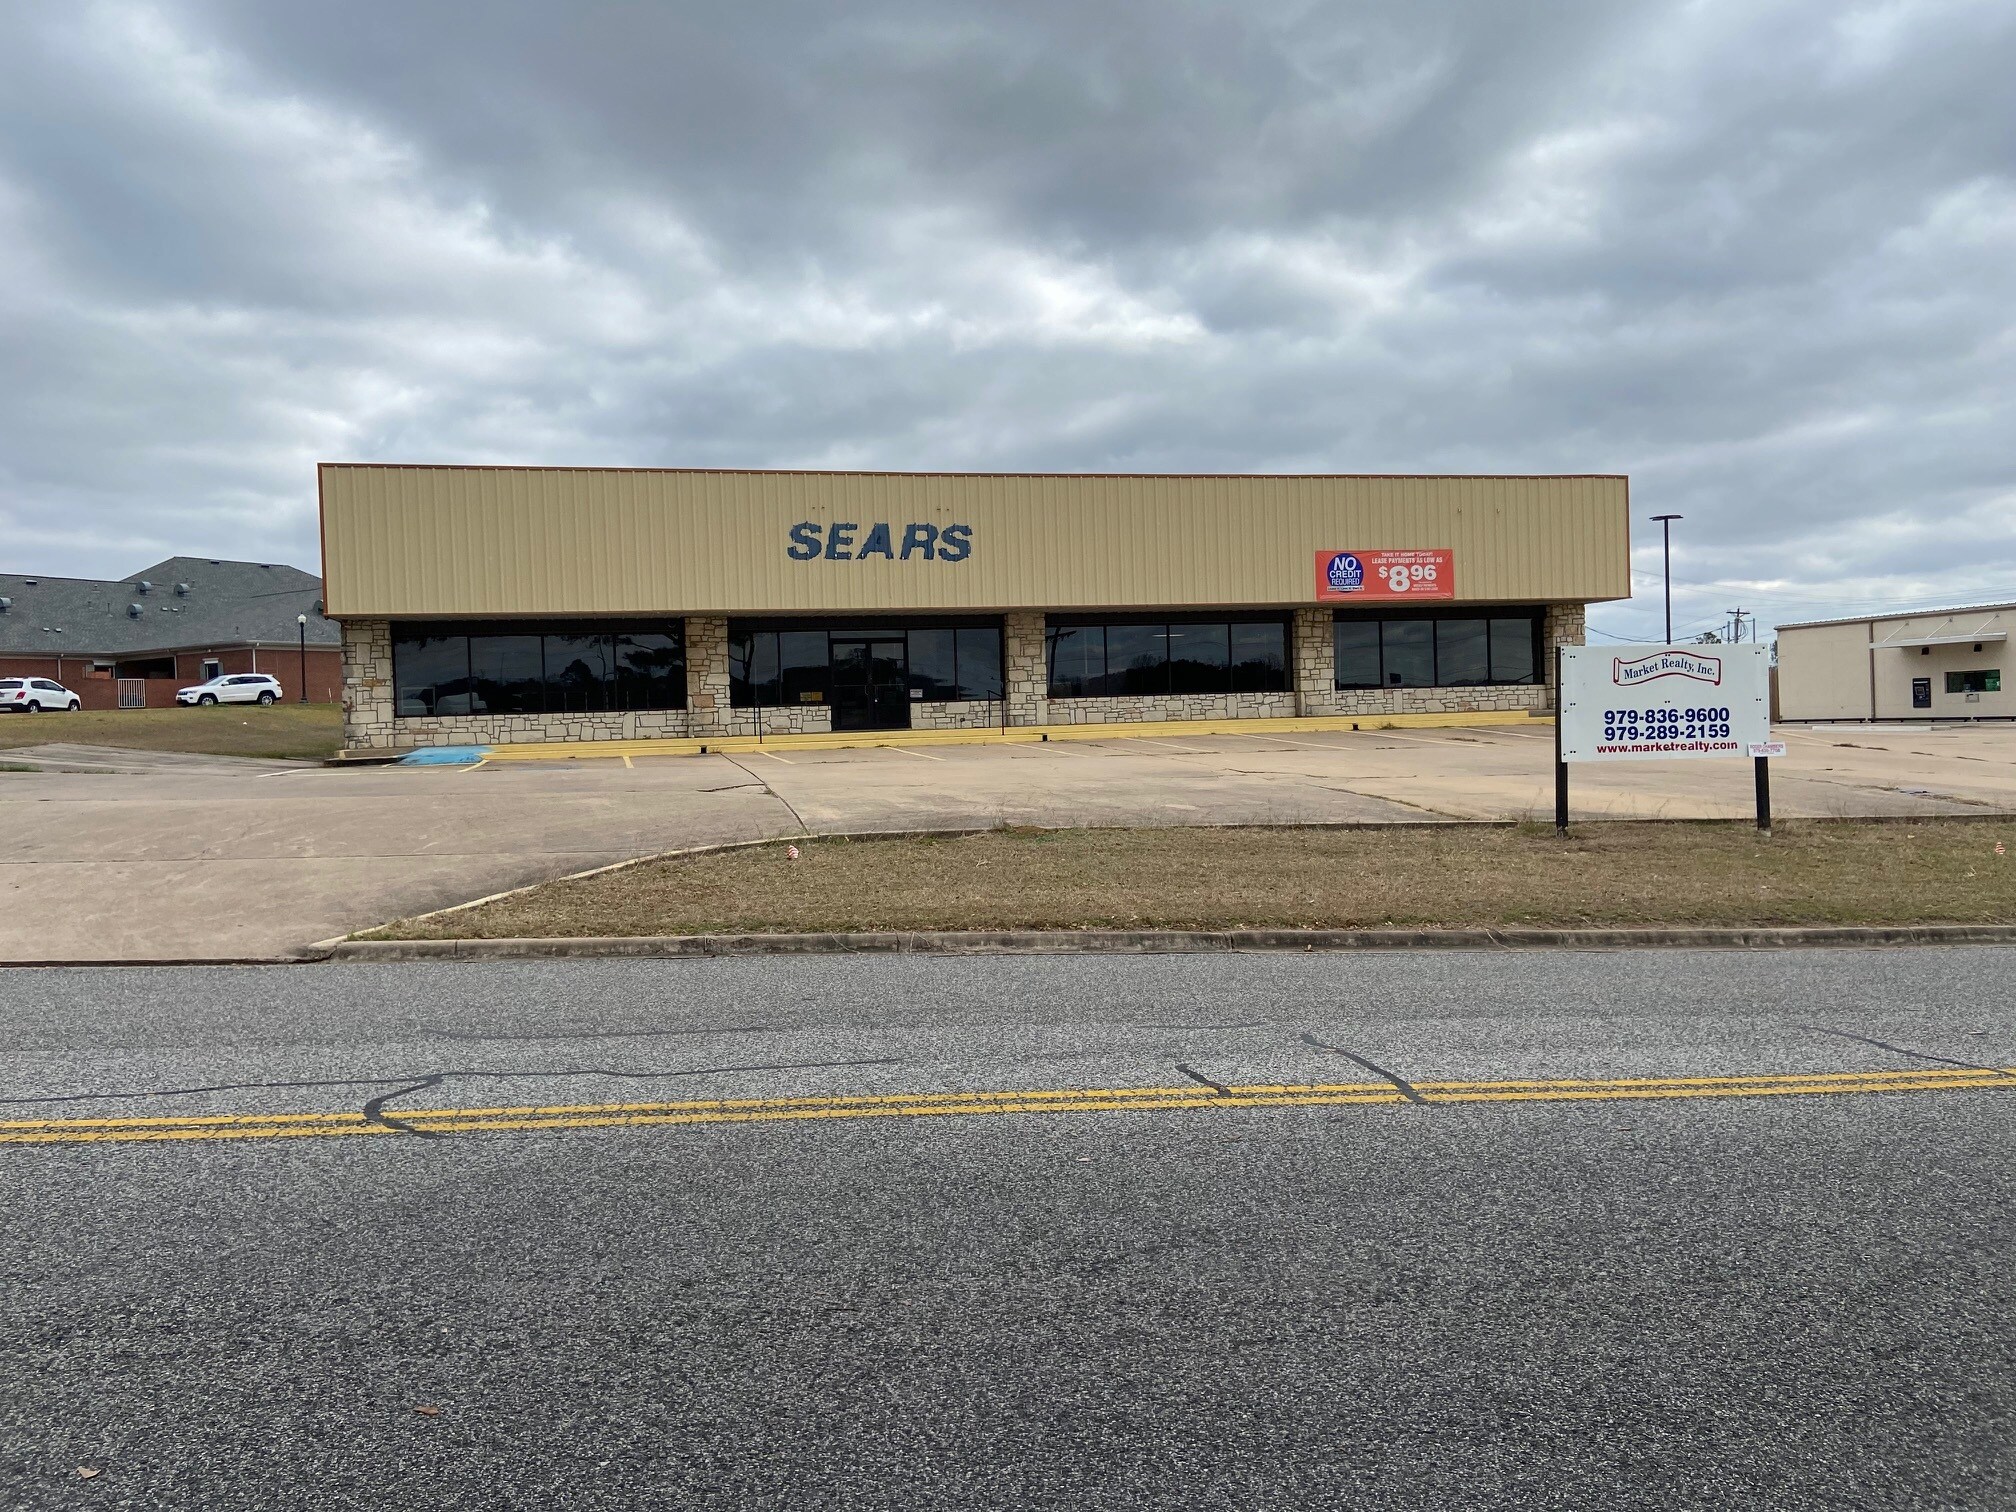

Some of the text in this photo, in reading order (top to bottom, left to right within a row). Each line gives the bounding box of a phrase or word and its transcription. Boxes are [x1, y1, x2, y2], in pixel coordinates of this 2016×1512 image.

[787, 521, 973, 562] SEARS
[1334, 556, 1356, 570] NO
[1330, 570, 1362, 578] CREDIT
[1624, 658, 1716, 680] Market Realty, Inc.
[1604, 707, 1730, 725] 979-836-9600
[1604, 724, 1730, 741] 979-289-2159
[1597, 741, 1738, 754] www.marketrealty.com
